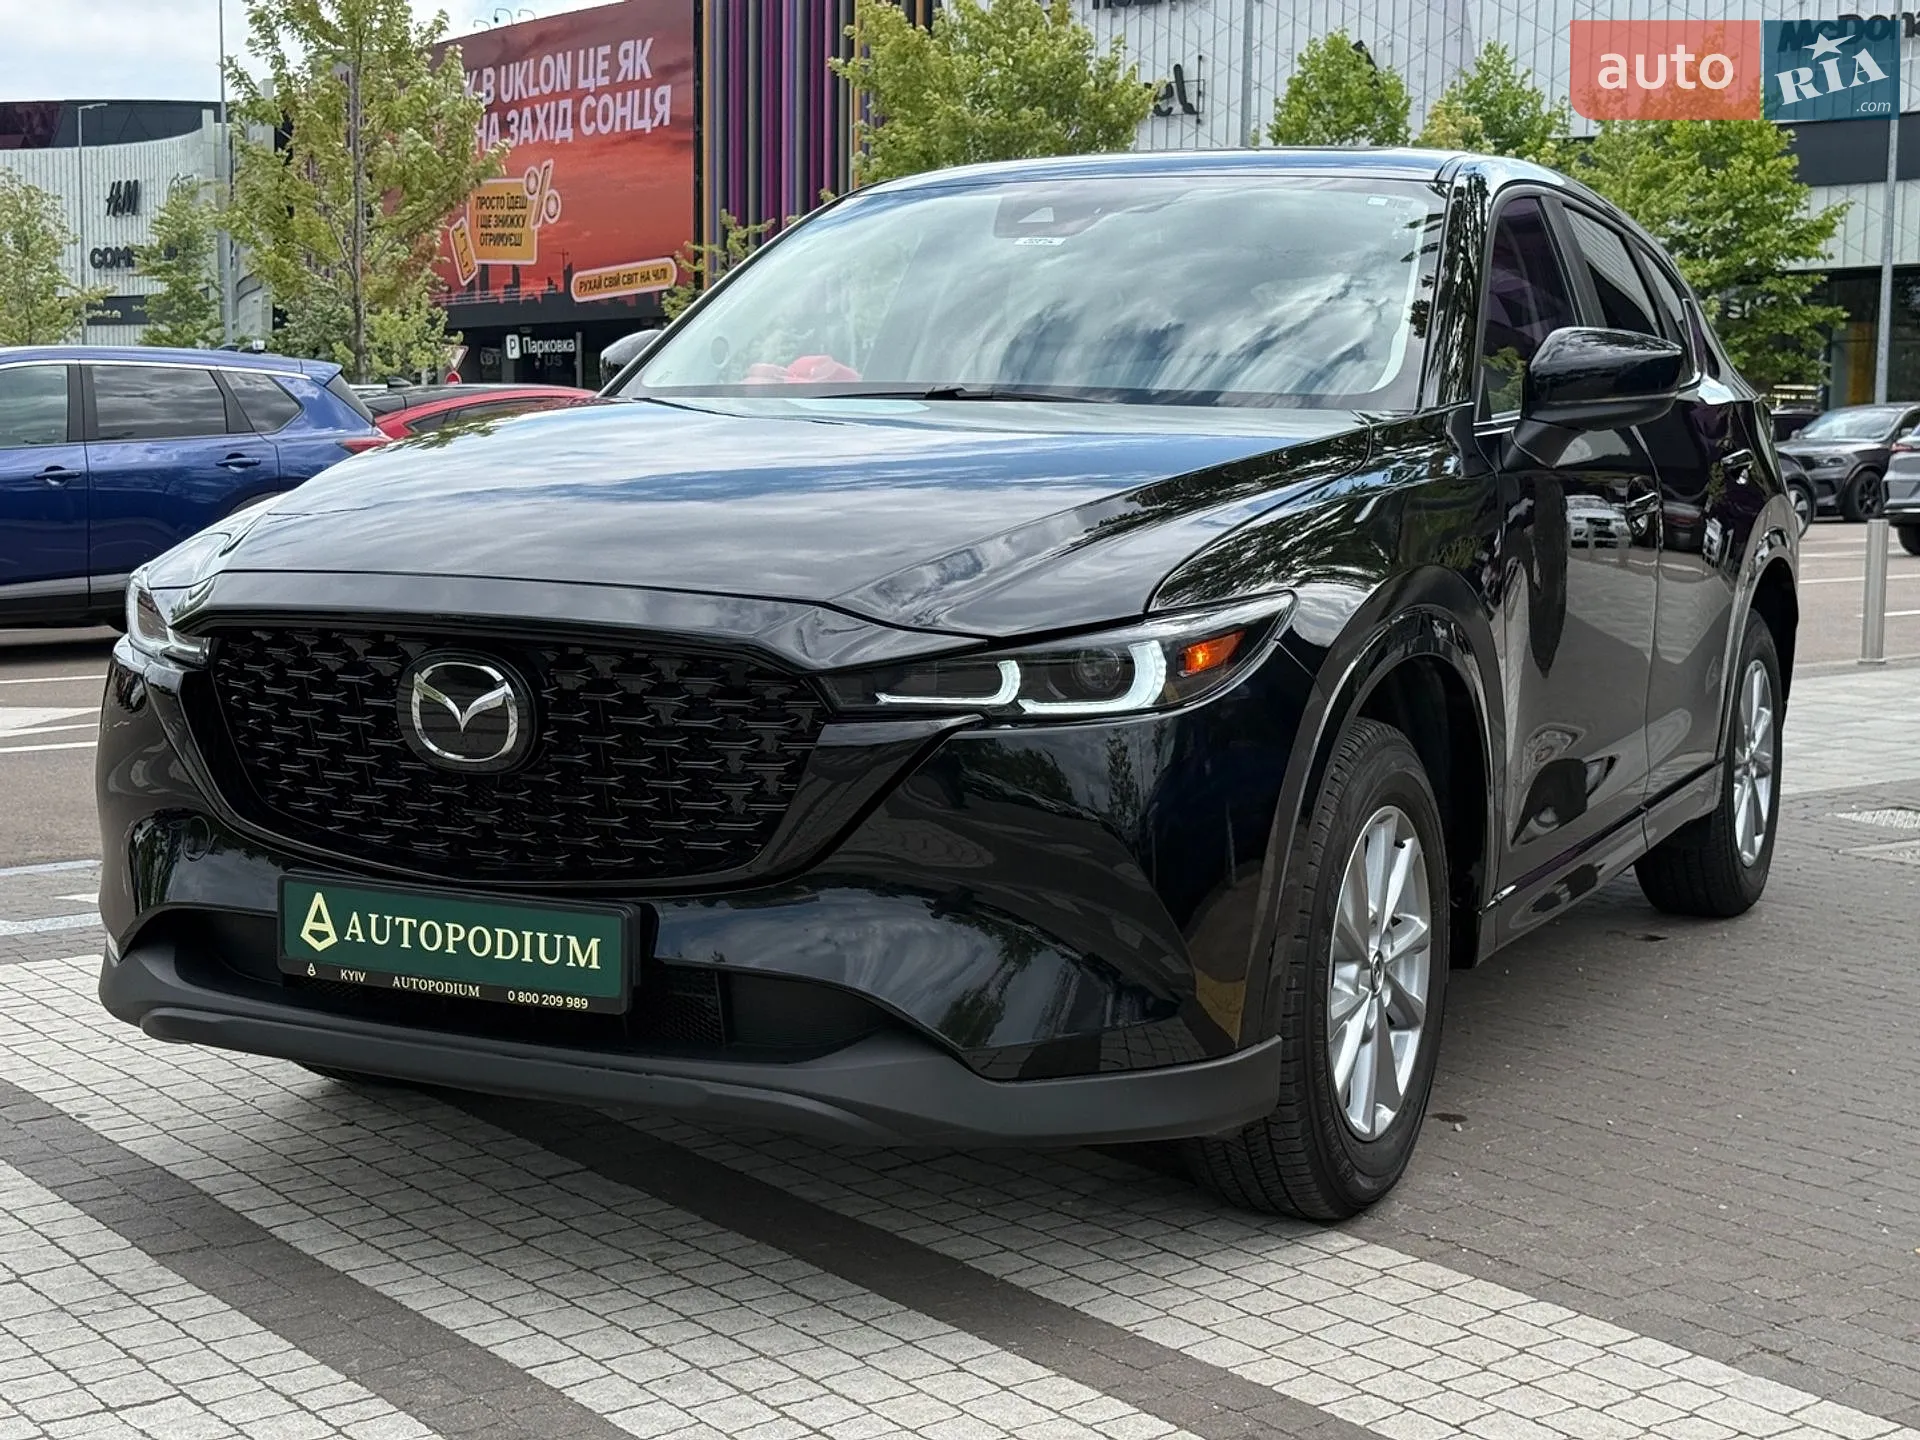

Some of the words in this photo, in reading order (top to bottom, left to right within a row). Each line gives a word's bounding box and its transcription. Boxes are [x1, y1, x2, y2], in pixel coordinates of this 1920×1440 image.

[501, 50, 572, 103] UKLON
[578, 44, 611, 92] ЦЕ
[616, 37, 654, 83] ЯК
[506, 98, 573, 148] ЗАХІД
[579, 84, 672, 136] СОНЦЯ
[476, 196, 505, 210] ПРОСТО
[494, 214, 527, 228] ЗНИЖКУ
[579, 275, 602, 293] РУХАЙ
[603, 272, 620, 288] СВІЙ
[621, 272, 639, 285] СВІТ
[640, 271, 650, 282] НА
[522, 336, 576, 359] Парковка
[344, 911, 601, 970] AUTOPODIUM
[340, 969, 366, 983] KYIV
[392, 975, 481, 998] AUTOPODIUM
[507, 990, 516, 1002] 0
[517, 991, 540, 1004] 800
[541, 994, 564, 1007] 209
[566, 996, 589, 1010] 989
